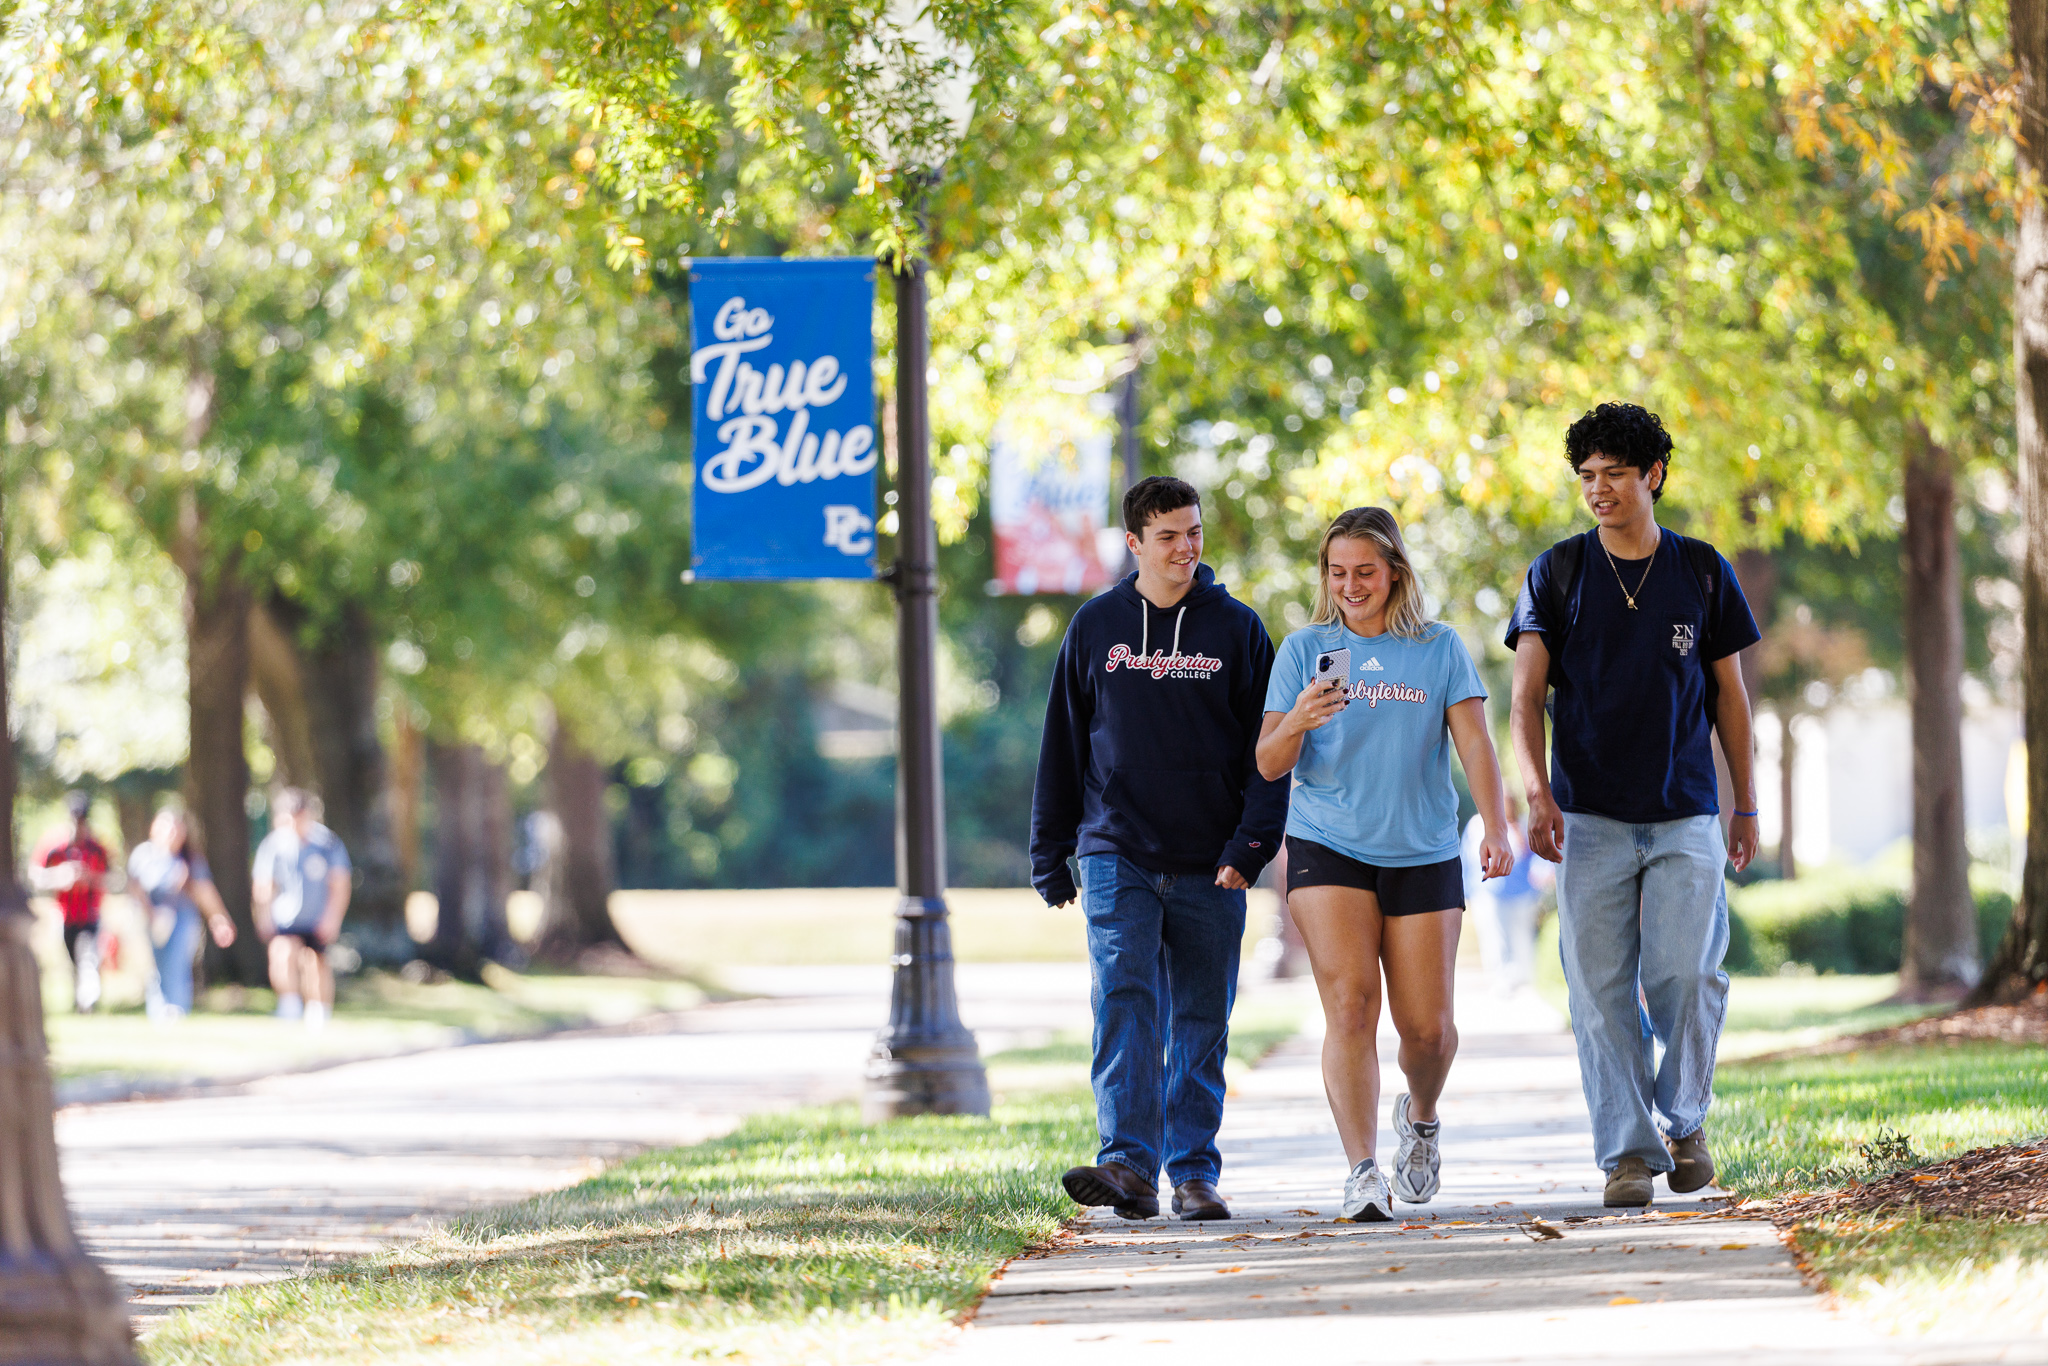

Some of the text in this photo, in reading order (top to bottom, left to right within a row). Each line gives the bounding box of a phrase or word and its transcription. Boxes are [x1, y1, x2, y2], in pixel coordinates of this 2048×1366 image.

[713, 296, 775, 341] Go
[690, 333, 848, 421] True
[702, 407, 878, 494] Blue
[823, 504, 872, 556] PC
[1170, 670, 1211, 680] COLLEGE
[1359, 663, 1384, 672] adidas
[1347, 678, 1428, 708] sbyterian
